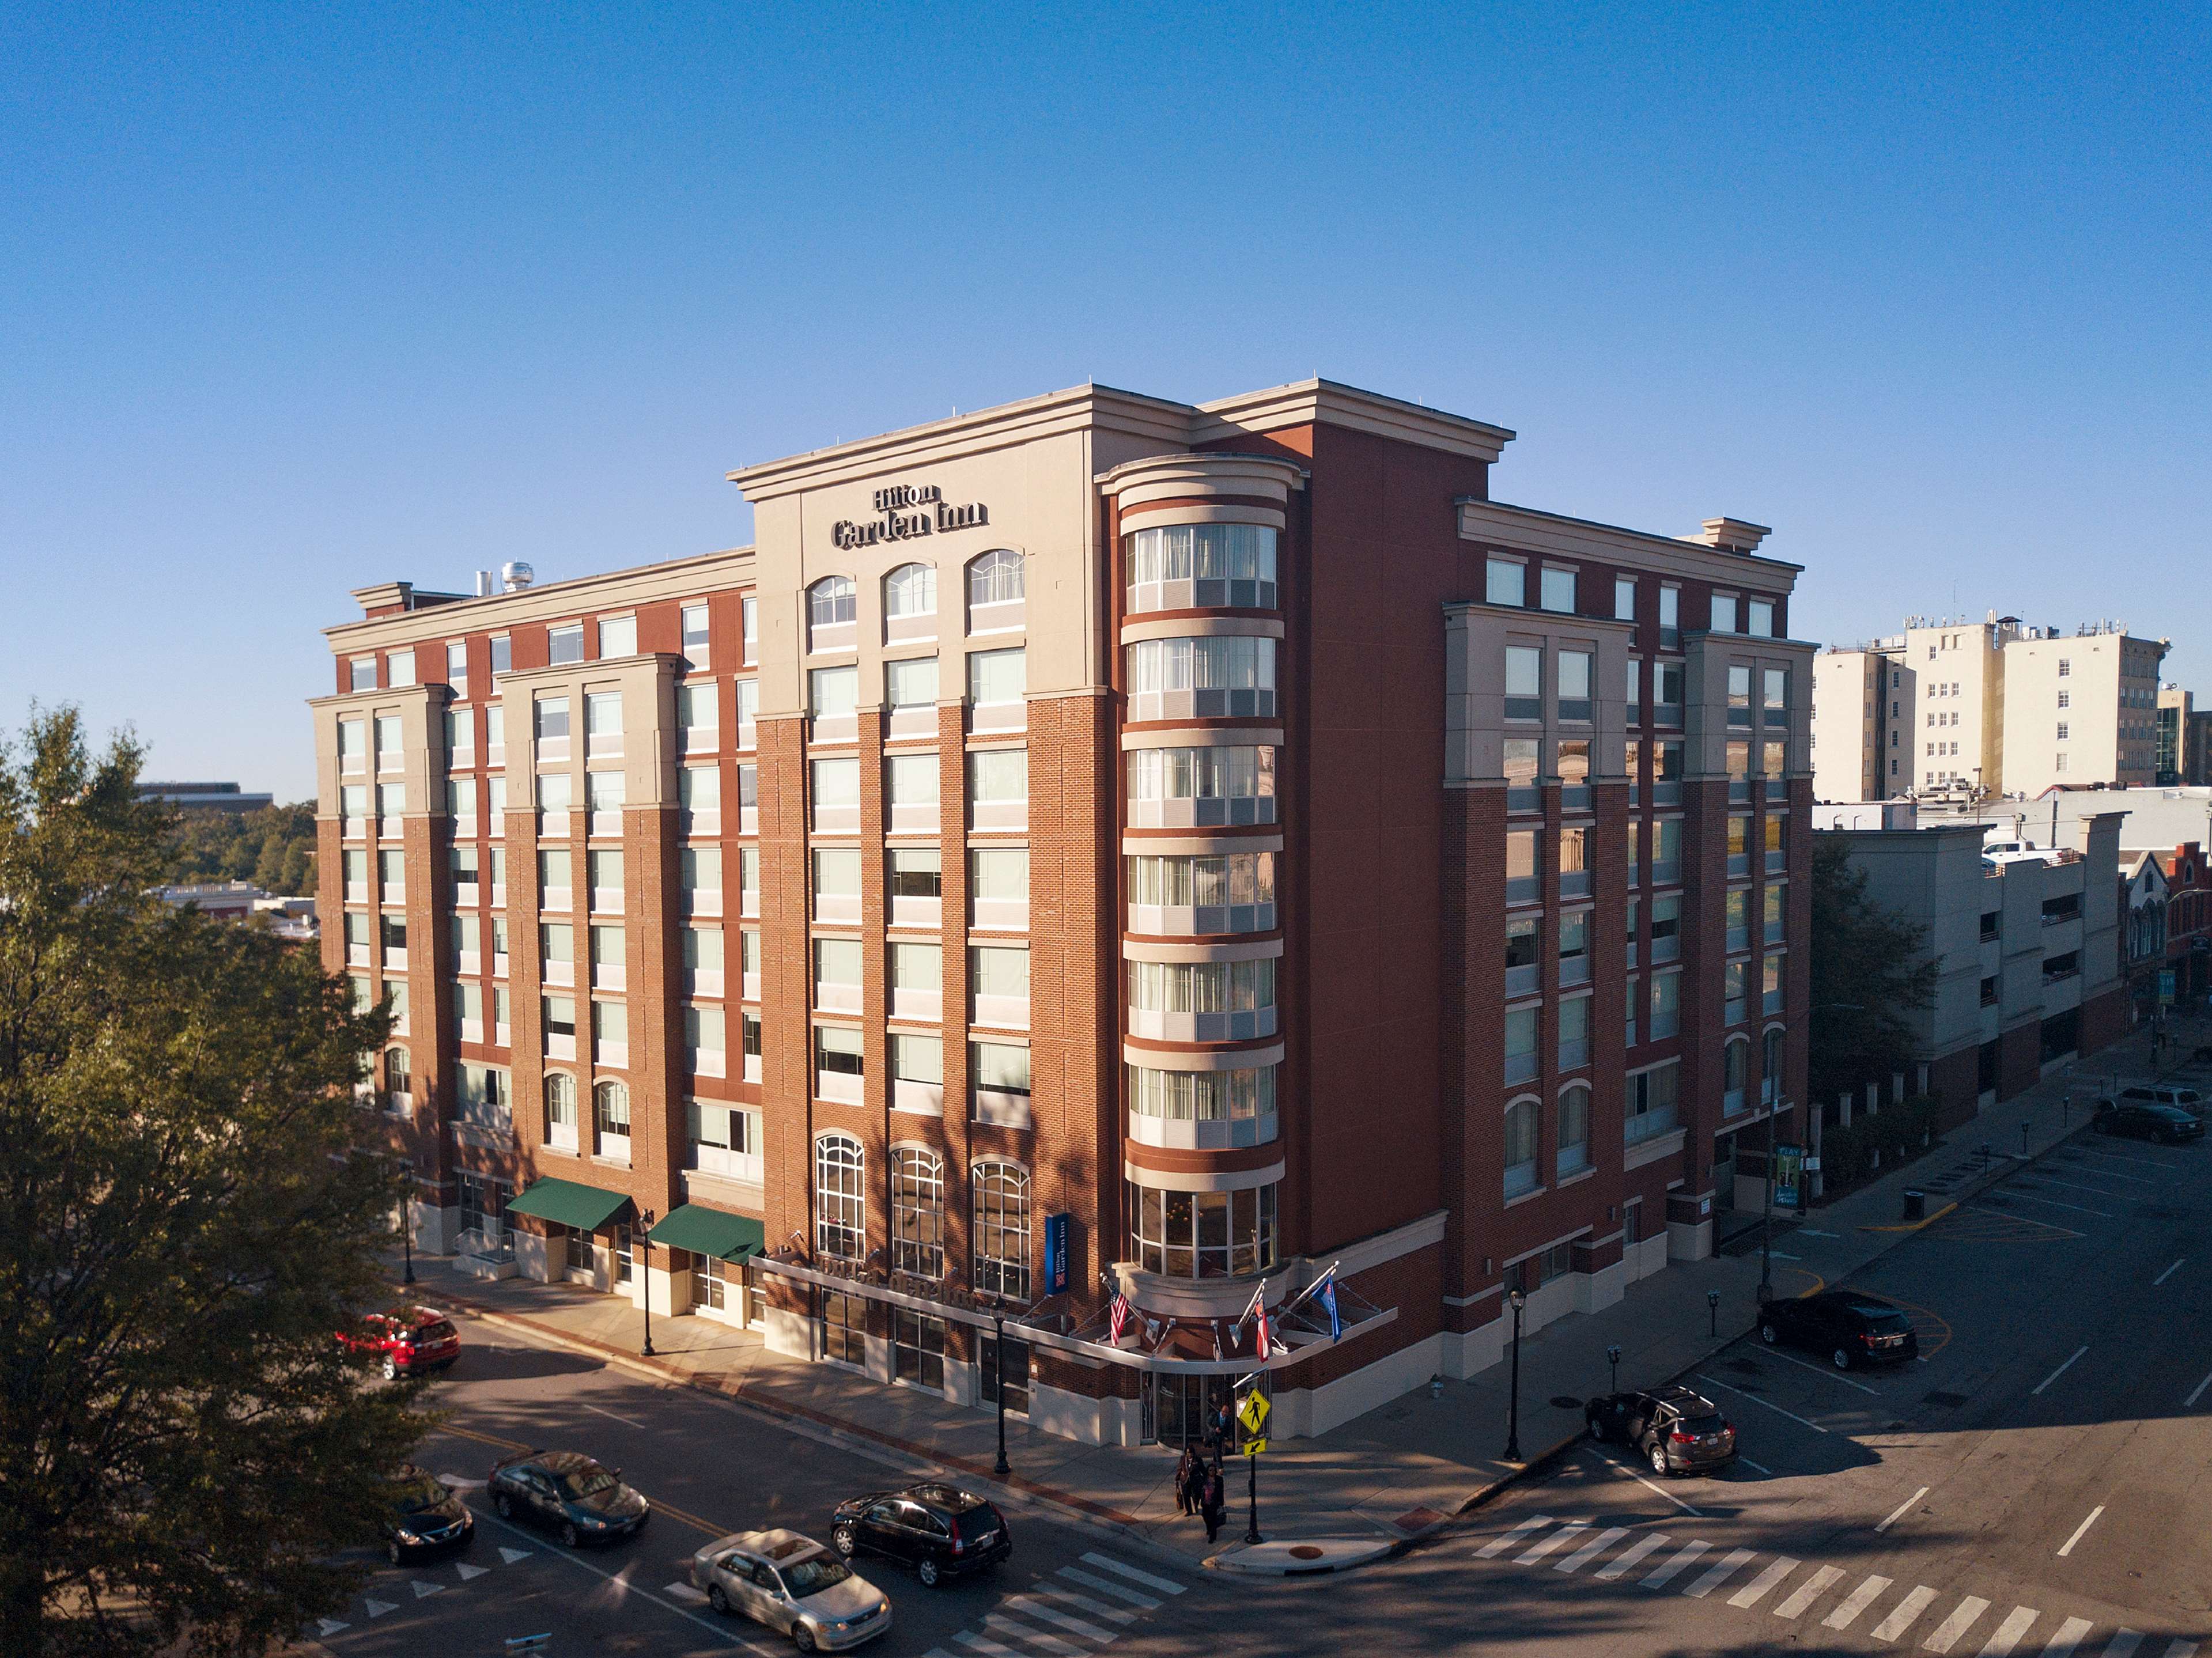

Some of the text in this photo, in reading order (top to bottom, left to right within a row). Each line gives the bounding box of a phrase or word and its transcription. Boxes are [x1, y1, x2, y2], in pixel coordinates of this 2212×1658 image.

[871, 484, 940, 512] Hilton
[831, 501, 988, 549] Garden Inn
[852, 1261, 931, 1300] Gaden
